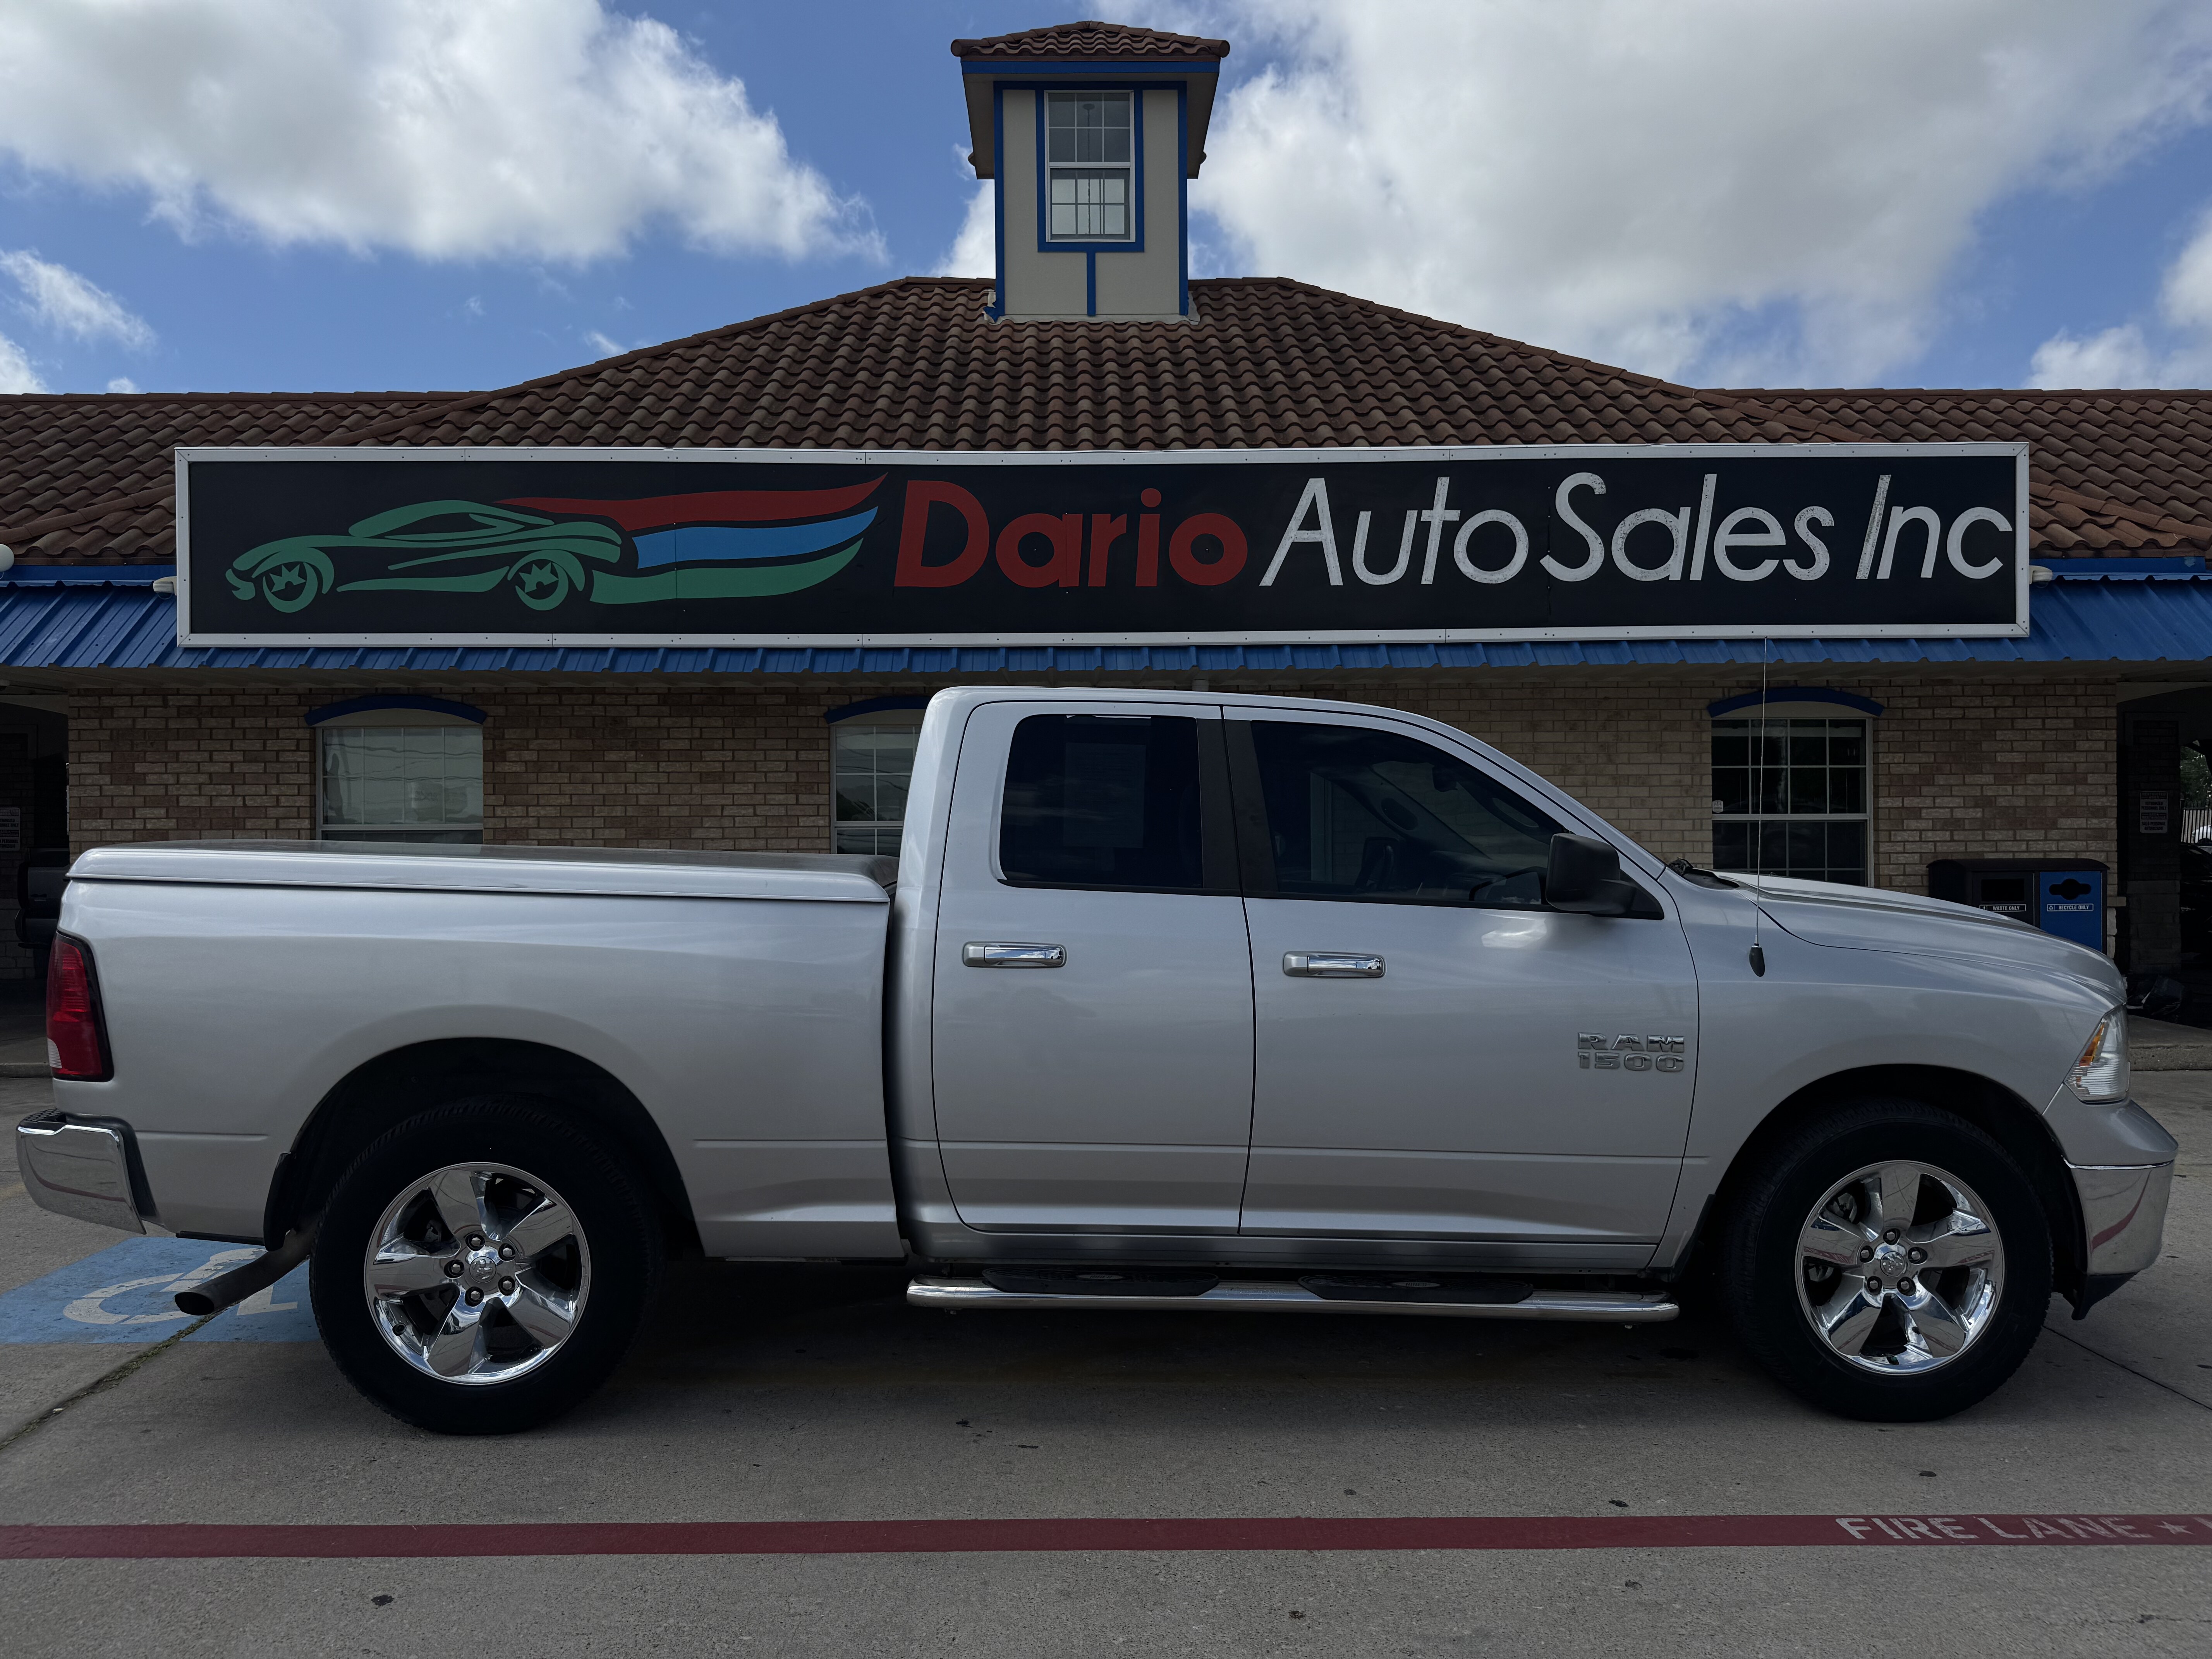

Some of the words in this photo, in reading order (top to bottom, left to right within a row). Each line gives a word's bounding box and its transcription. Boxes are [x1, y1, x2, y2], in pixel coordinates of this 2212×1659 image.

[894, 479, 1248, 588] Dario
[1259, 477, 1529, 586] Auto
[1539, 472, 1834, 582] Sales
[1856, 474, 2013, 580] Inc
[1578, 1032, 1685, 1053] RAM
[1578, 1051, 1684, 1073] 1500
[1835, 1517, 1980, 1539] FIRE
[1976, 1517, 2155, 1539] LANE
